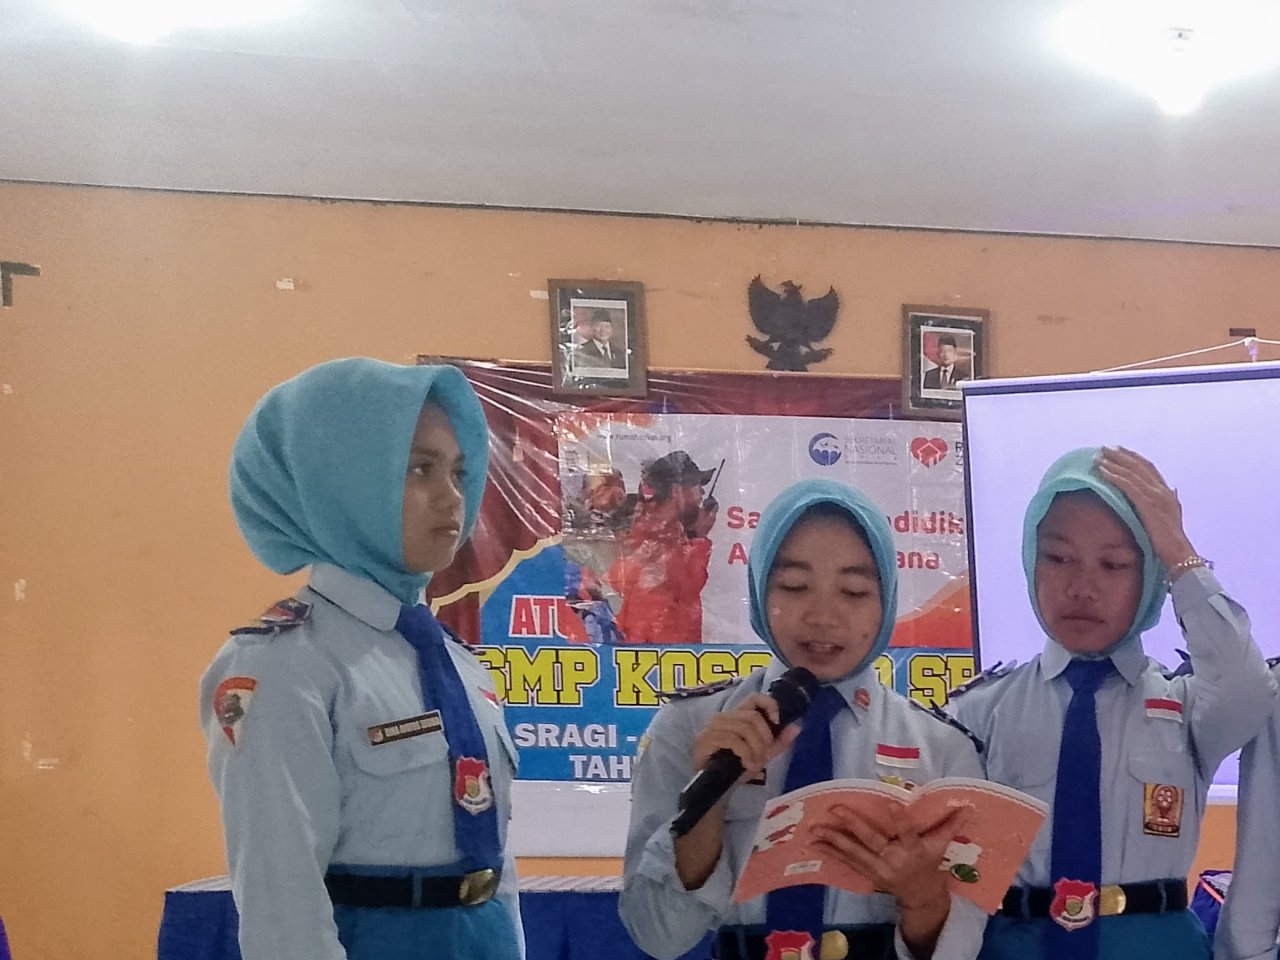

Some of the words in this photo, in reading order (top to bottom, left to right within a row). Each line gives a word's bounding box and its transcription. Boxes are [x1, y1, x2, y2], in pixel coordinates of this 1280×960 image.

[844, 444, 897, 455] NASIONAL
[514, 723, 617, 748] SRAGI
[569, 755, 637, 779] TAH
